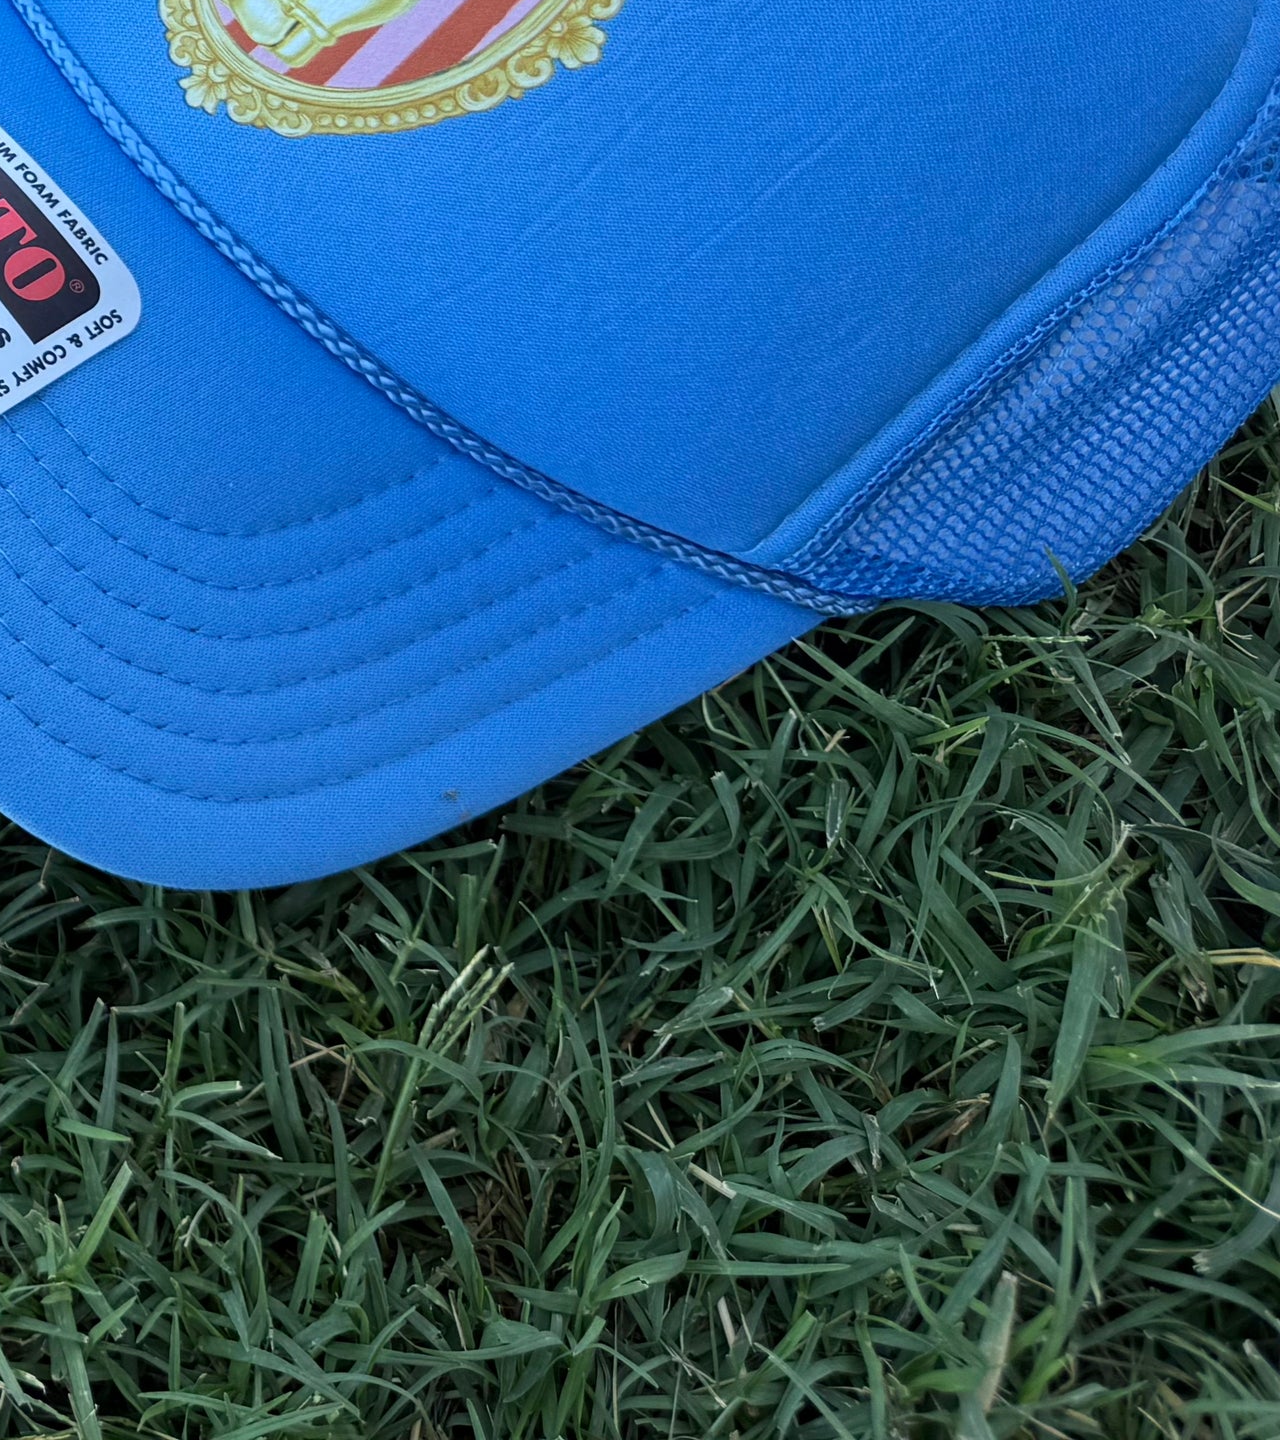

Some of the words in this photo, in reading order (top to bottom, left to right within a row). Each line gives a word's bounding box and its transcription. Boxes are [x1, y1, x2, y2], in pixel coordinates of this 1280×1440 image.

[15, 162, 58, 209] FOAM
[57, 207, 108, 266] FABRIC
[66, 334, 83, 347] &
[86, 309, 123, 338] SOFT
[15, 344, 67, 387] COMFY
